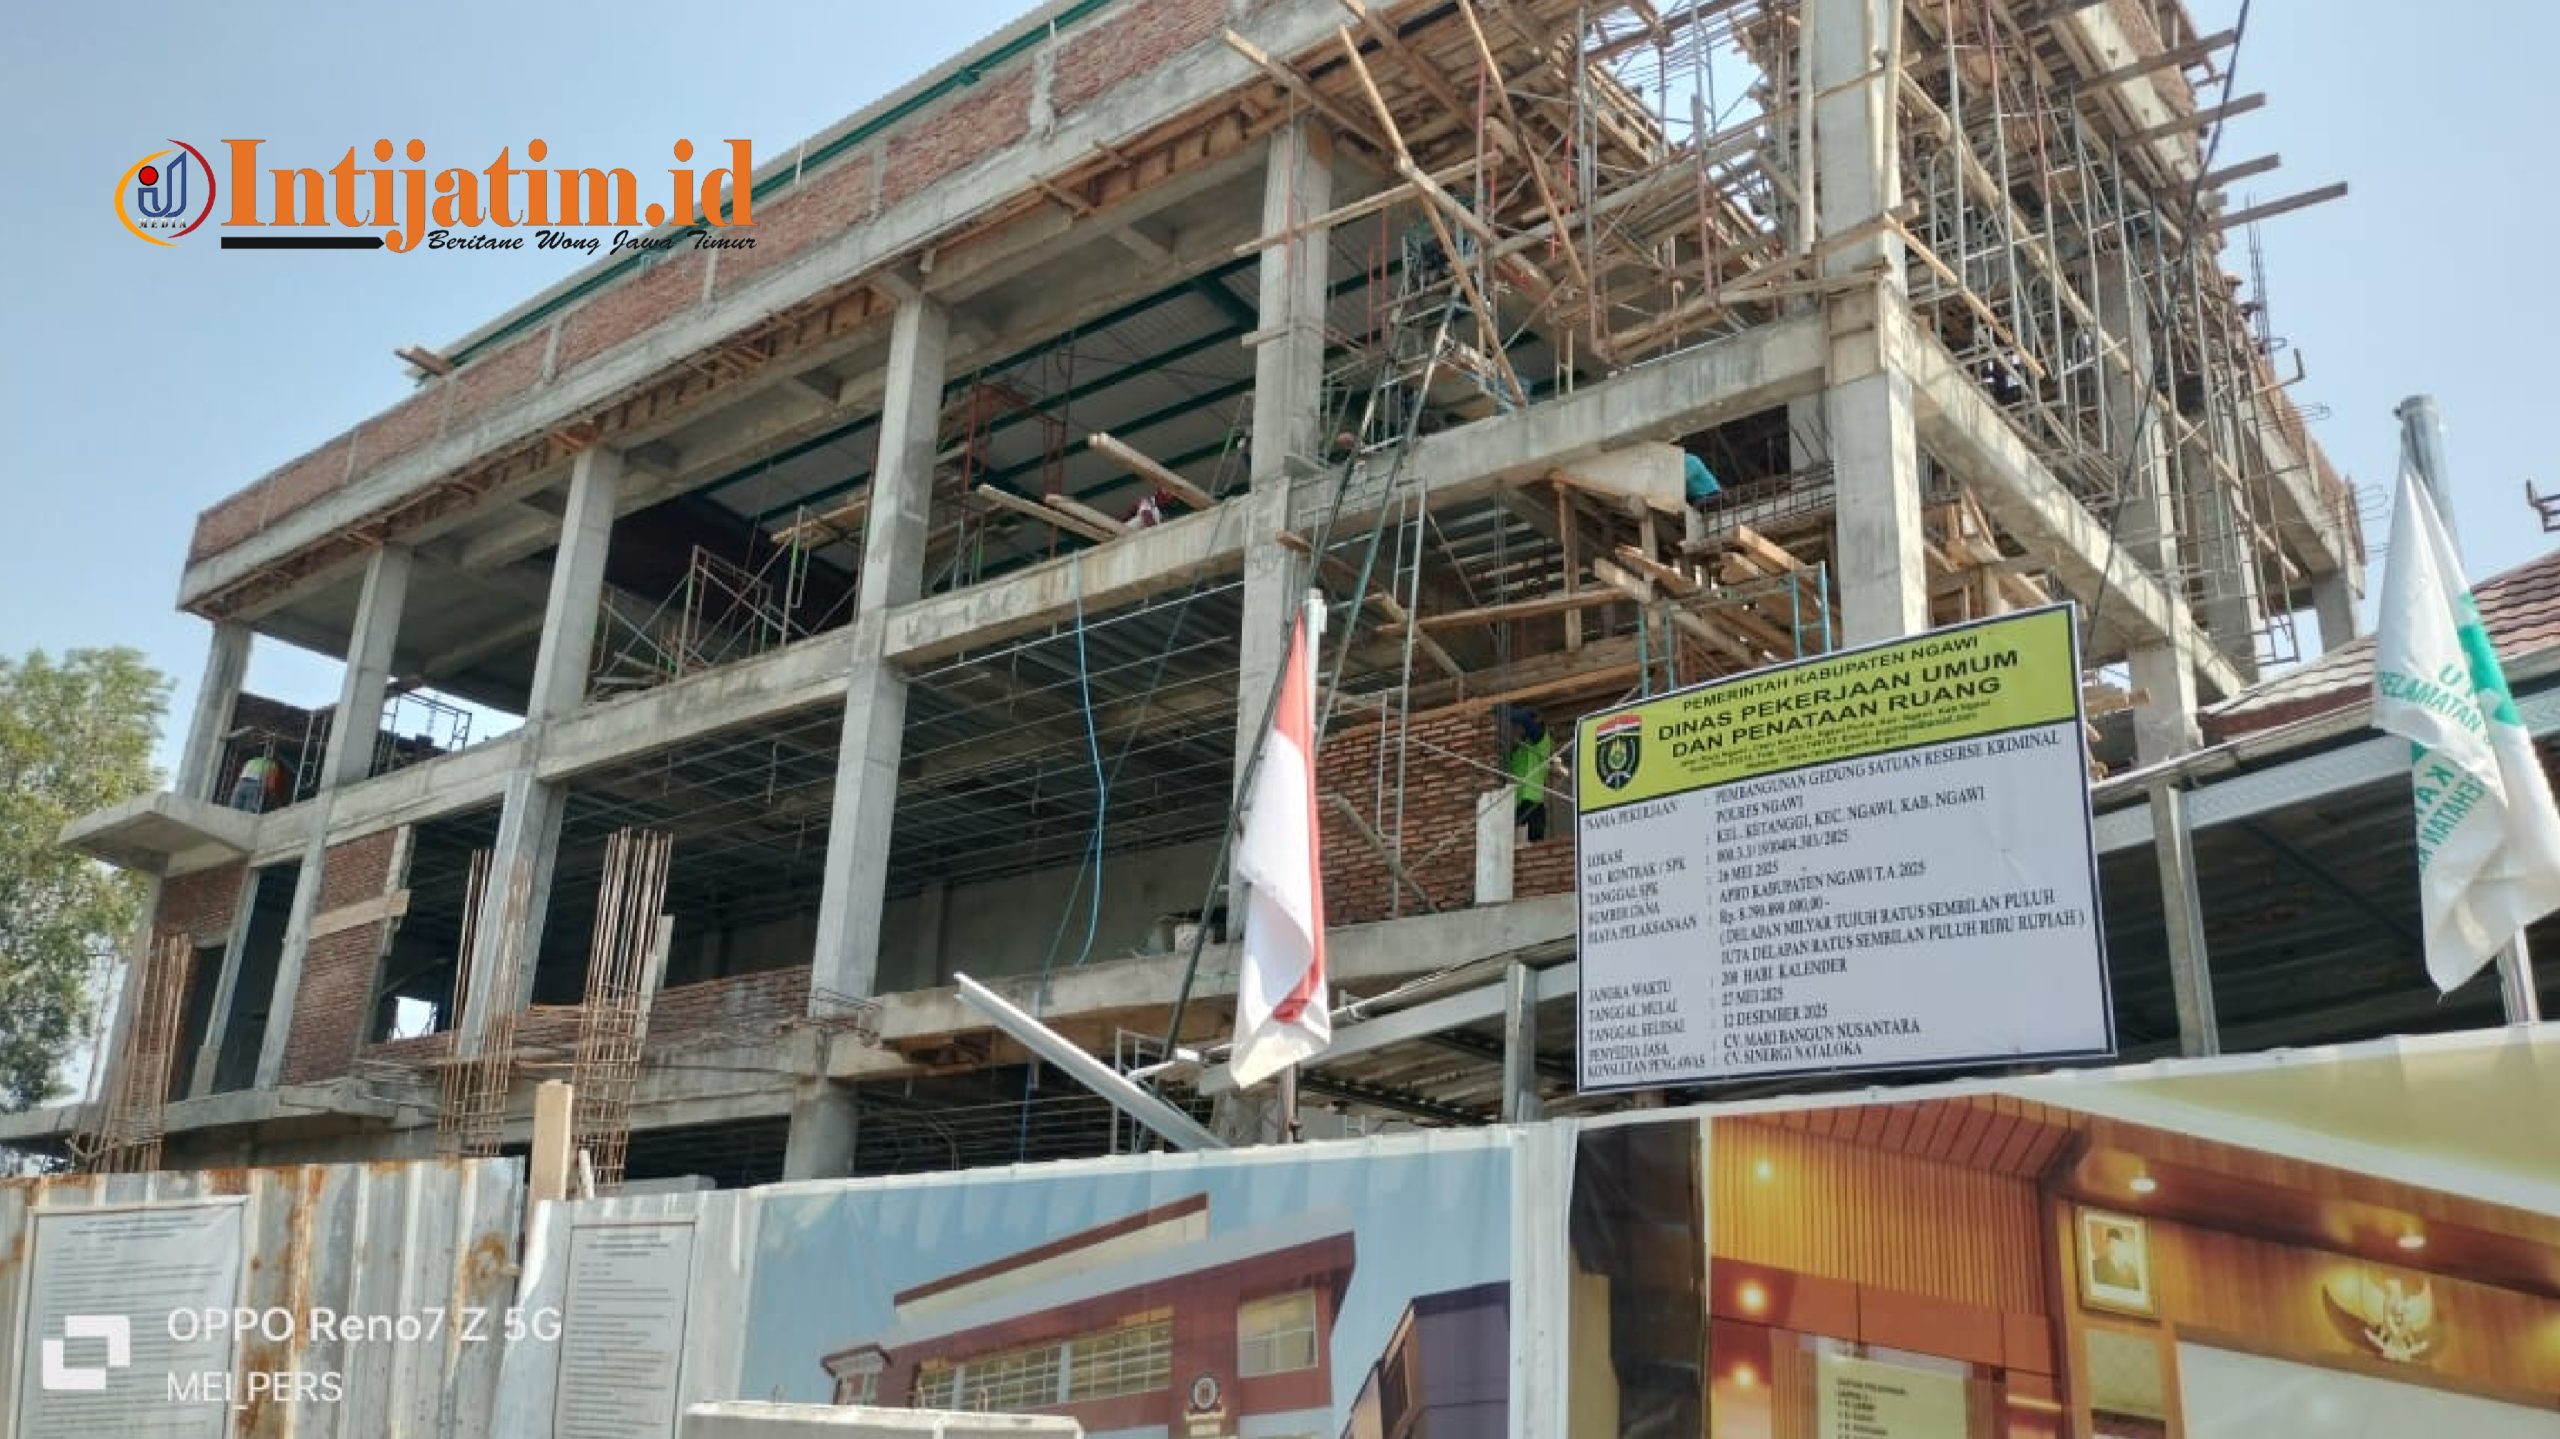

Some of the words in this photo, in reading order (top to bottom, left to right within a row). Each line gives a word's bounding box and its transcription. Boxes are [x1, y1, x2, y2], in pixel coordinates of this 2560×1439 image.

[1684, 677, 1788, 712] PEMERINTAH
[1794, 652, 1904, 686] KABUPATEN
[1911, 635, 1978, 660] NGAWI
[1659, 711, 1732, 740] DINAS
[1742, 671, 1910, 721] PEKERJAAN
[1923, 650, 2018, 682] UMUM
[1672, 734, 1723, 758] DAN
[1732, 701, 1877, 744] PENATAAN
[1889, 677, 2001, 711] RUANG
[1716, 776, 1806, 804] PEMBANGUNAN
[1809, 765, 1866, 786] GEDUNG
[1868, 754, 1921, 775] SATUAN
[1925, 743, 1982, 767] RESERSE
[1988, 730, 2061, 756] KRIMINAL
[1936, 786, 1984, 807] NGAWI
[1716, 802, 1759, 824] POLRES
[1762, 795, 1803, 814] NGAWI
[1587, 849, 1622, 867] LOKASI
[1608, 862, 1656, 883] KONTRAK
[1666, 858, 1686, 872] SPK
[1731, 865, 1752, 880] MEI
[1755, 860, 1778, 876] 2025
[1752, 876, 1823, 899] KABUPATEN
[1827, 867, 1872, 887] NGAWI
[1900, 861, 1926, 877] 2025
[1588, 886, 1638, 905] TANGGAL
[1784, 916, 1831, 934] MILYAR
[1835, 908, 1878, 928] TUJUH
[1880, 905, 1925, 924] RATUS
[1927, 895, 2000, 917] SEMBILAN
[2005, 889, 2056, 908] PULUH
[1722, 948, 1749, 964] JUTA
[1753, 940, 1808, 961] DELAPAN
[1813, 933, 1853, 952] RATUS
[1856, 927, 1924, 947] SEMBILAN
[1929, 921, 1977, 939] PULUH
[1981, 916, 2014, 934] RIBU
[1744, 967, 1772, 985] HARI
[1779, 957, 1847, 979] KALENDER
[1632, 980, 1671, 995] WAKTU
[1737, 989, 1758, 1004] MEI
[1760, 987, 1783, 1002] 2025
[1589, 1003, 1641, 1021] TANGGAL
[1737, 1006, 1800, 1026] DESEMBER
[1804, 1002, 1827, 1019] 2025
[1589, 1024, 1641, 1041] TANGGAL
[1779, 1024, 1833, 1044] BANGUN
[1837, 1017, 1920, 1038] NUSANTARA
[1744, 1047, 1792, 1064] SINERGI
[1795, 1041, 1863, 1060] NATALOKA
